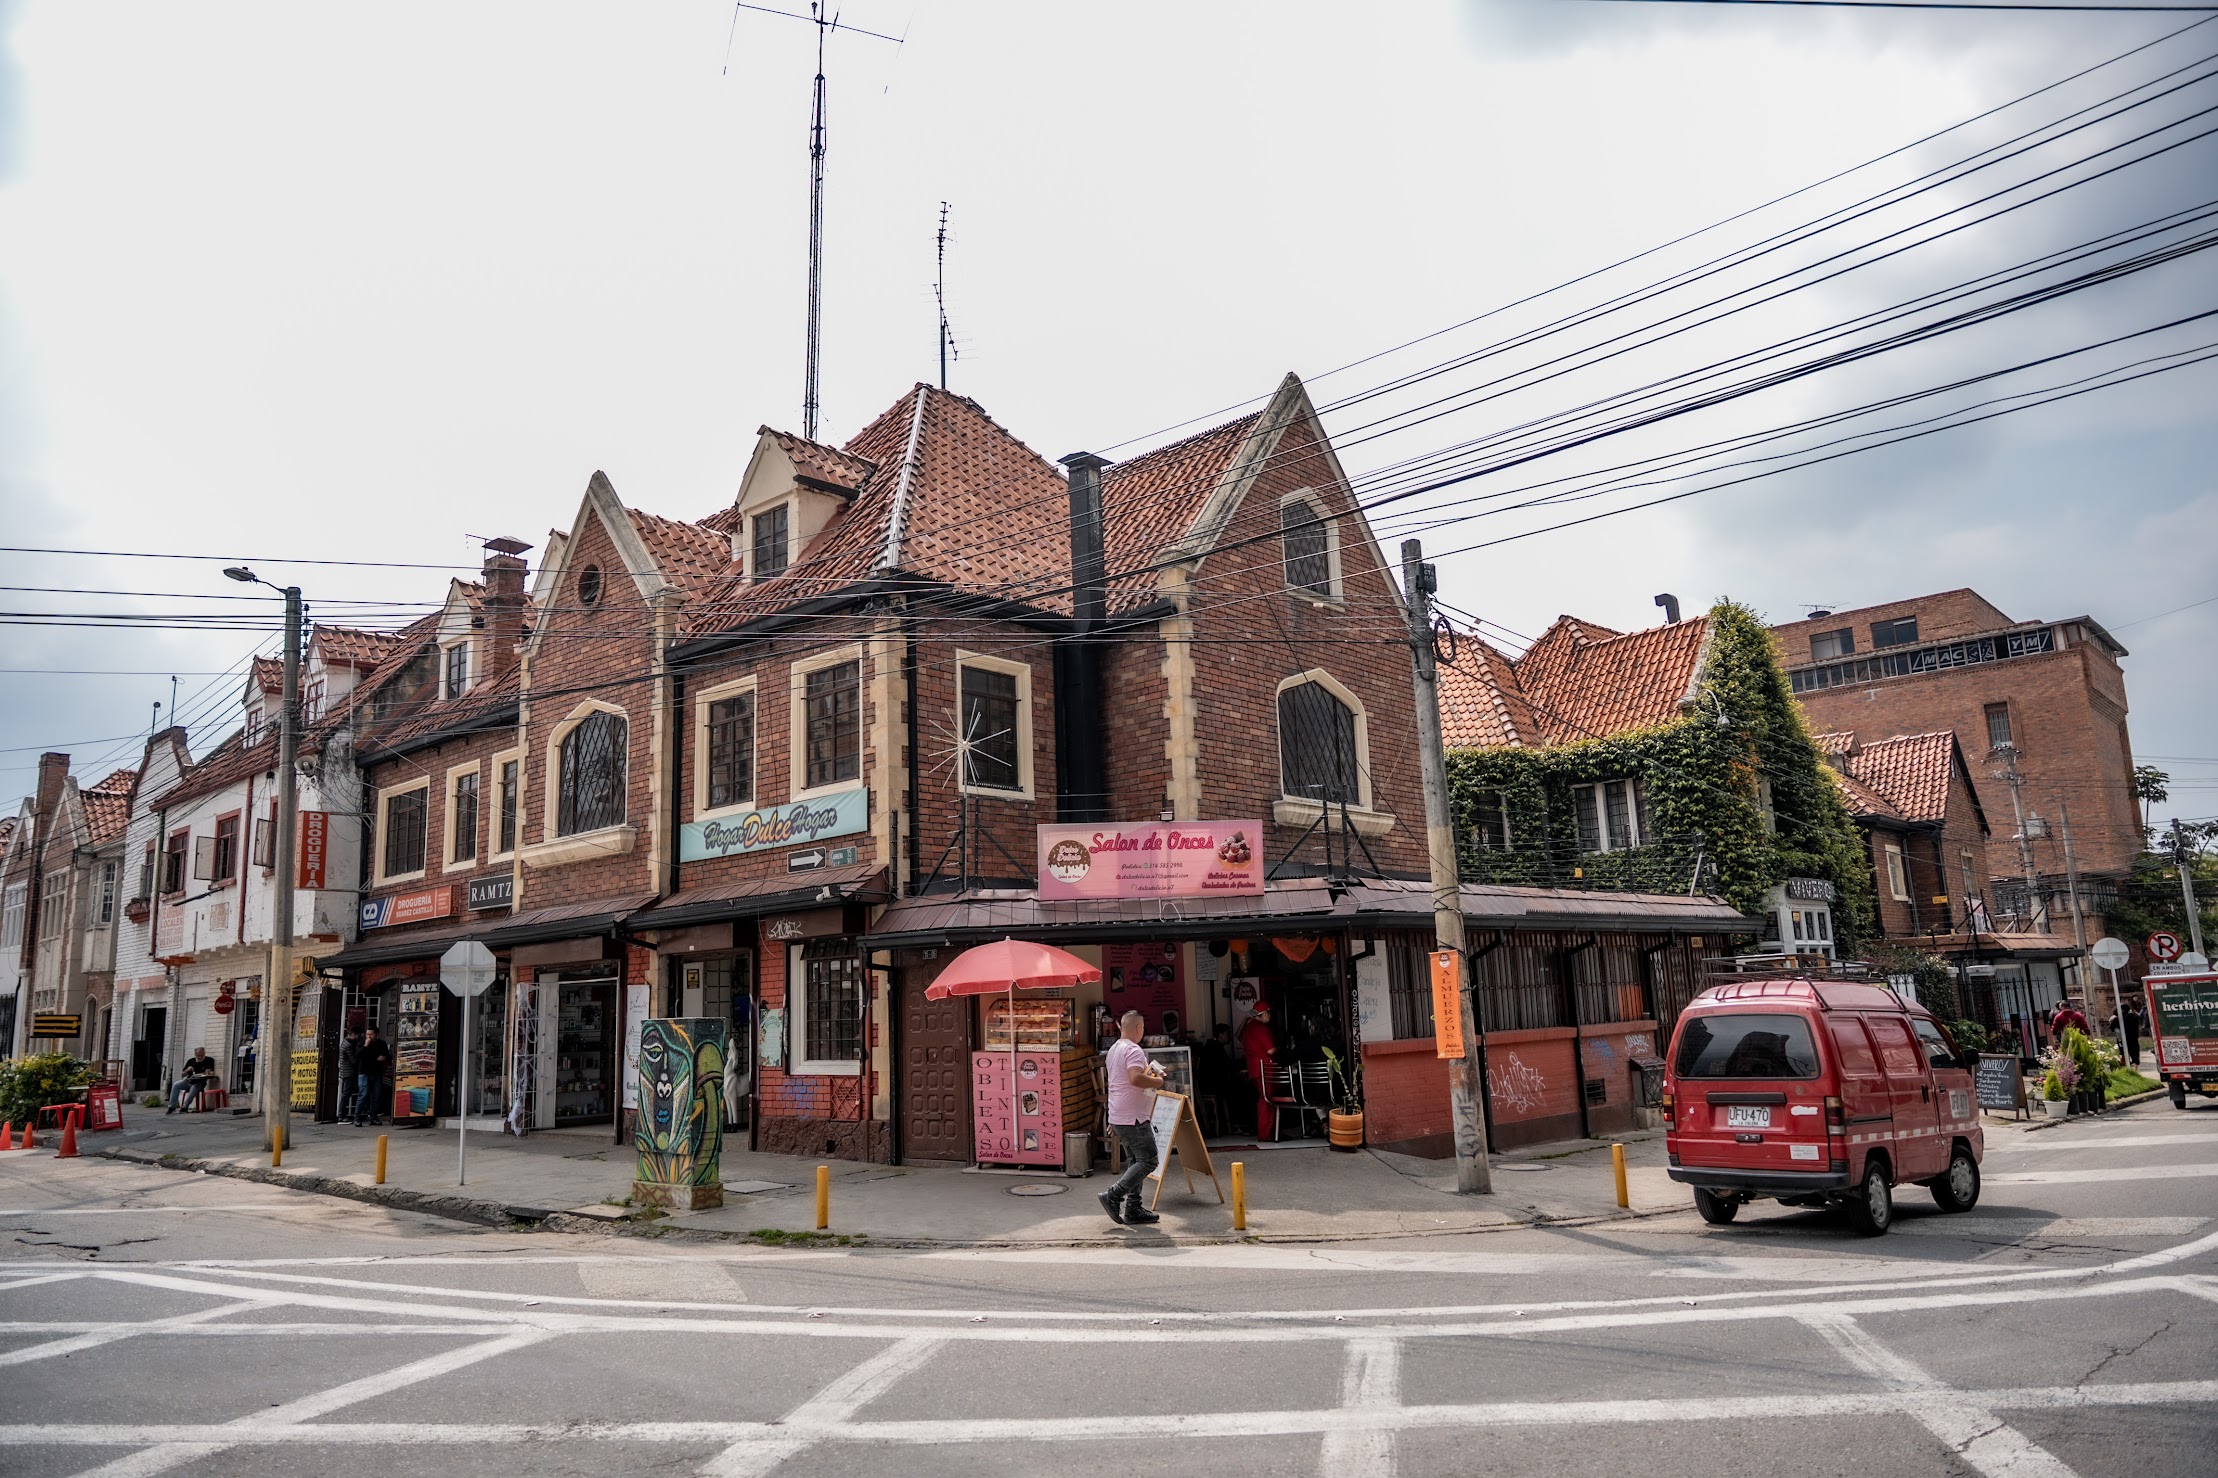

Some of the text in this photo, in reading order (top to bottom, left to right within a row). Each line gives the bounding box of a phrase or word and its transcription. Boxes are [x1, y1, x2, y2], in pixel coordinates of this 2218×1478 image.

[1924, 649, 1964, 665] MAC
[704, 804, 838, 854] Hogar Dulce Hogar
[1089, 831, 1214, 853] Salon de Onces
[471, 881, 512, 902] RAMTZ
[1790, 880, 1833, 899] VIVERO
[397, 893, 432, 909] DROGUERÍA
[402, 983, 438, 993] RAMTZ
[1441, 970, 1455, 1039] ALMUERZOS
[1981, 1059, 2004, 1069] VIVERO
[977, 1057, 993, 1150] OBLEAS
[998, 1058, 1010, 1151] TINTO
[1040, 1057, 1057, 1160] MERENGONES
